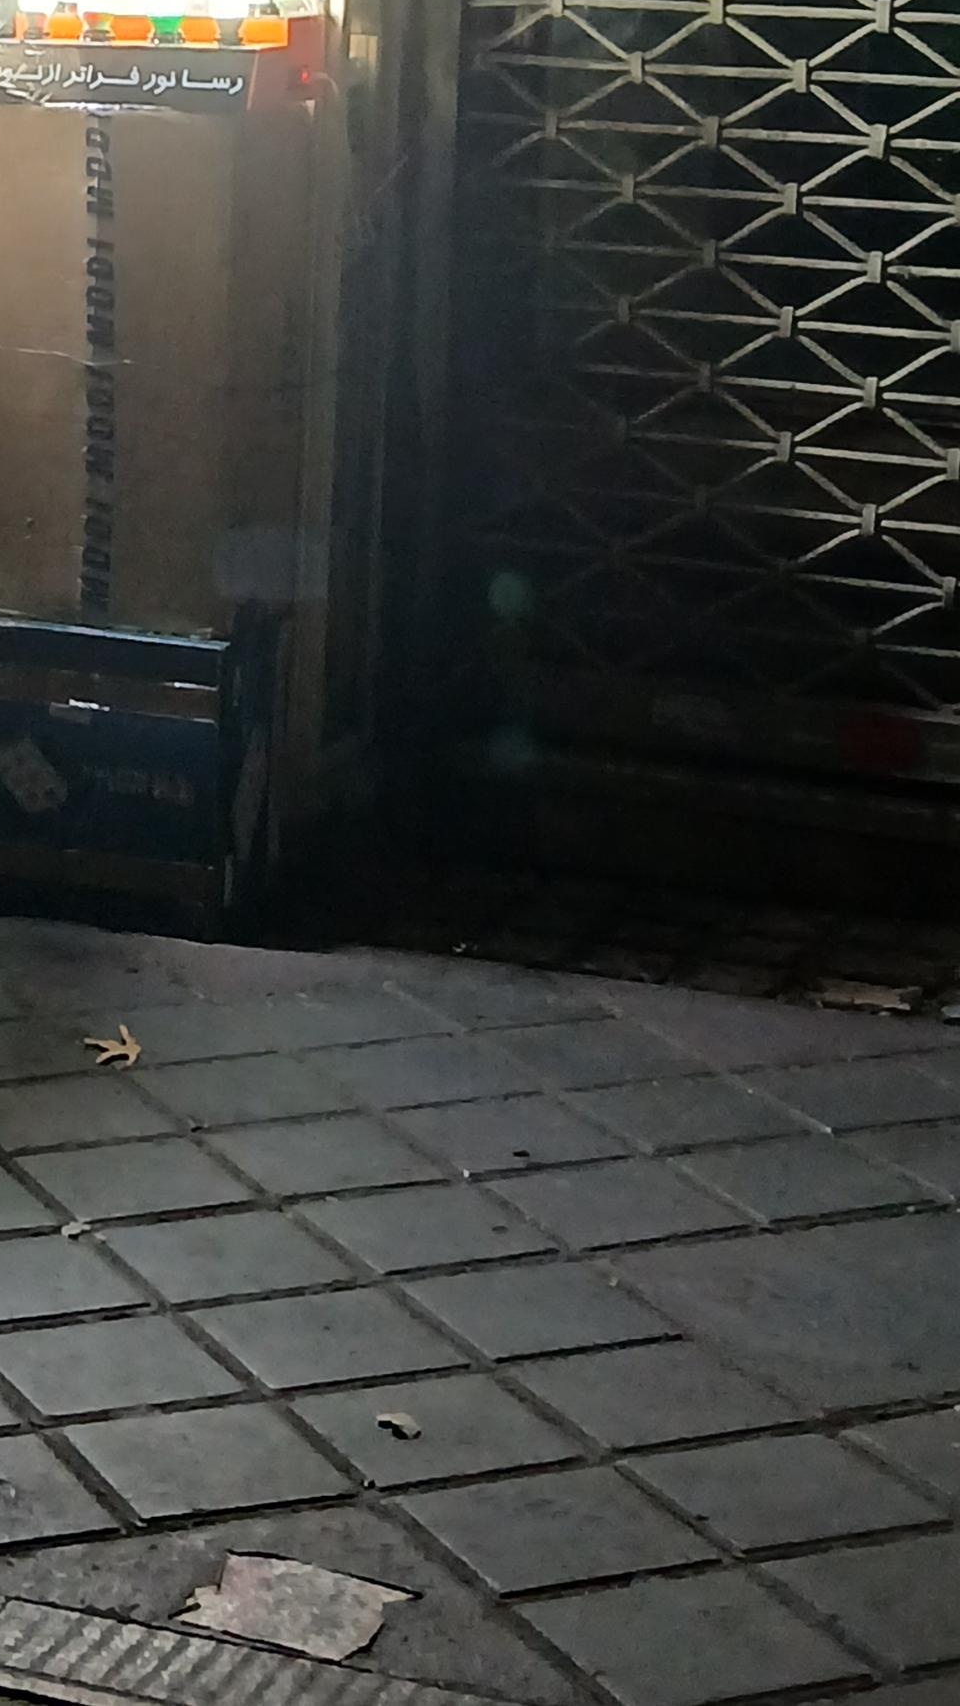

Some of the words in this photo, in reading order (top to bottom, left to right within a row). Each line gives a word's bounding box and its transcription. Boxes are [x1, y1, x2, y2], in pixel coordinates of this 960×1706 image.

[62, 64, 141, 90] فراتر
[142, 68, 177, 95] نور
[182, 68, 244, 95] رسا
